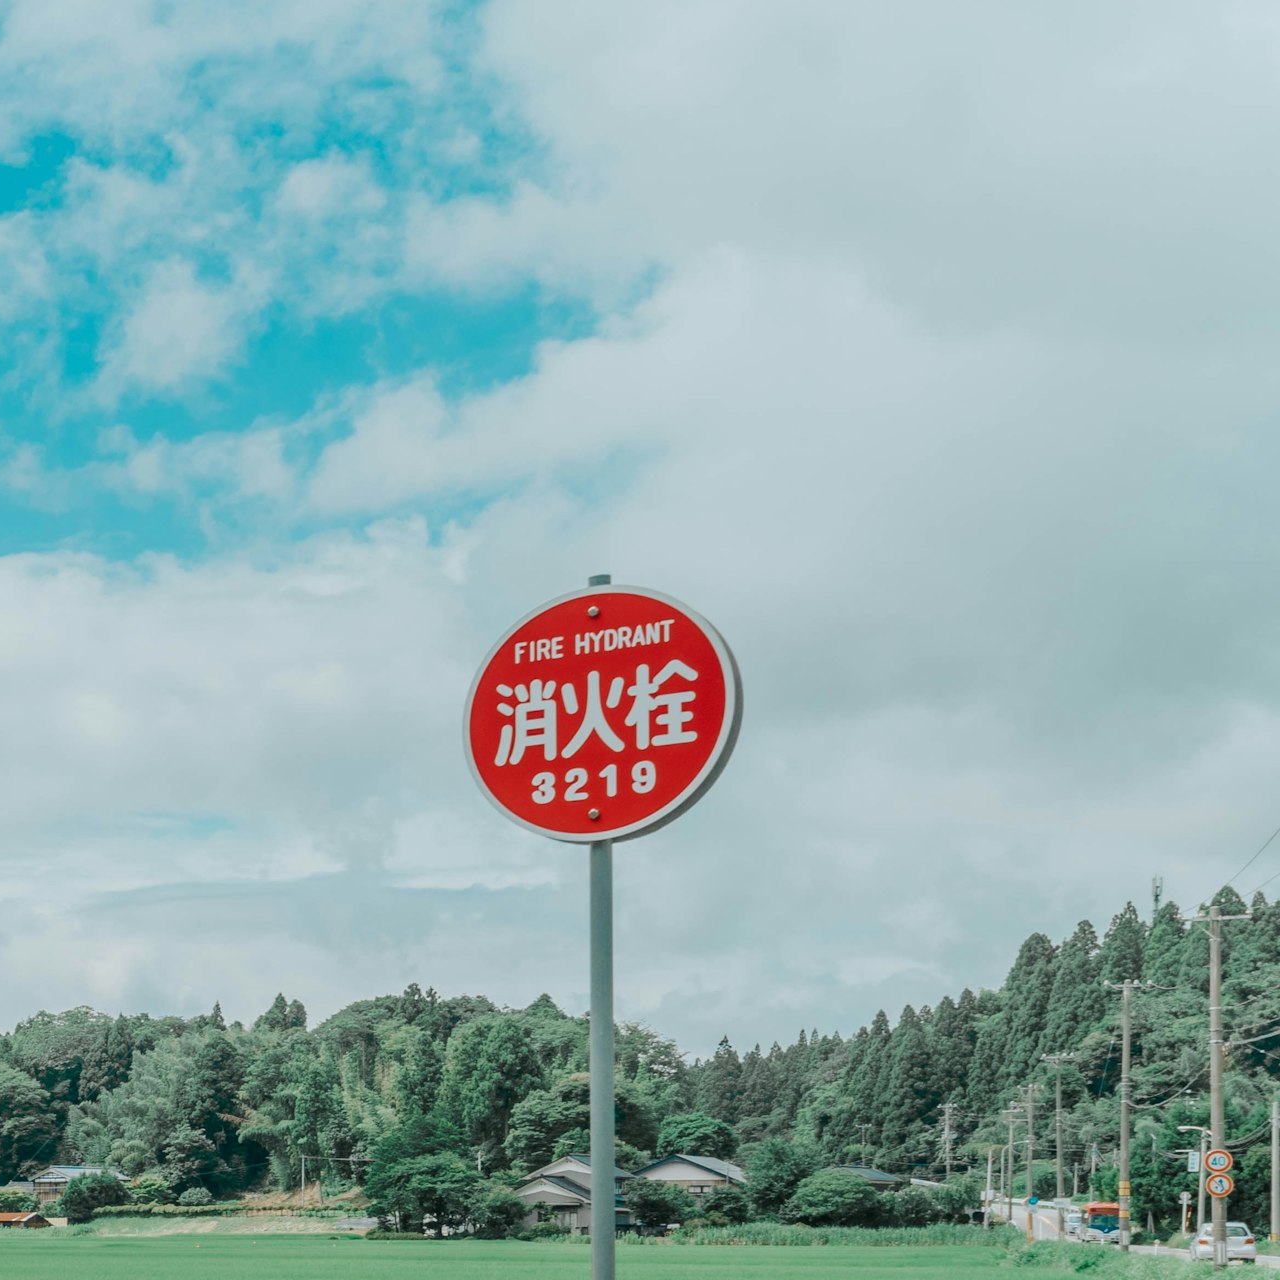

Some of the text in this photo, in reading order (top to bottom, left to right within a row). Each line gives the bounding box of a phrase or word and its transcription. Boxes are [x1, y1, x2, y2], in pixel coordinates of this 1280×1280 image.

[514, 618, 676, 664] FIRE HYDRANT
[494, 659, 699, 766] 消火栓
[531, 760, 656, 804] 3219
[1210, 1155, 1227, 1167] 40
